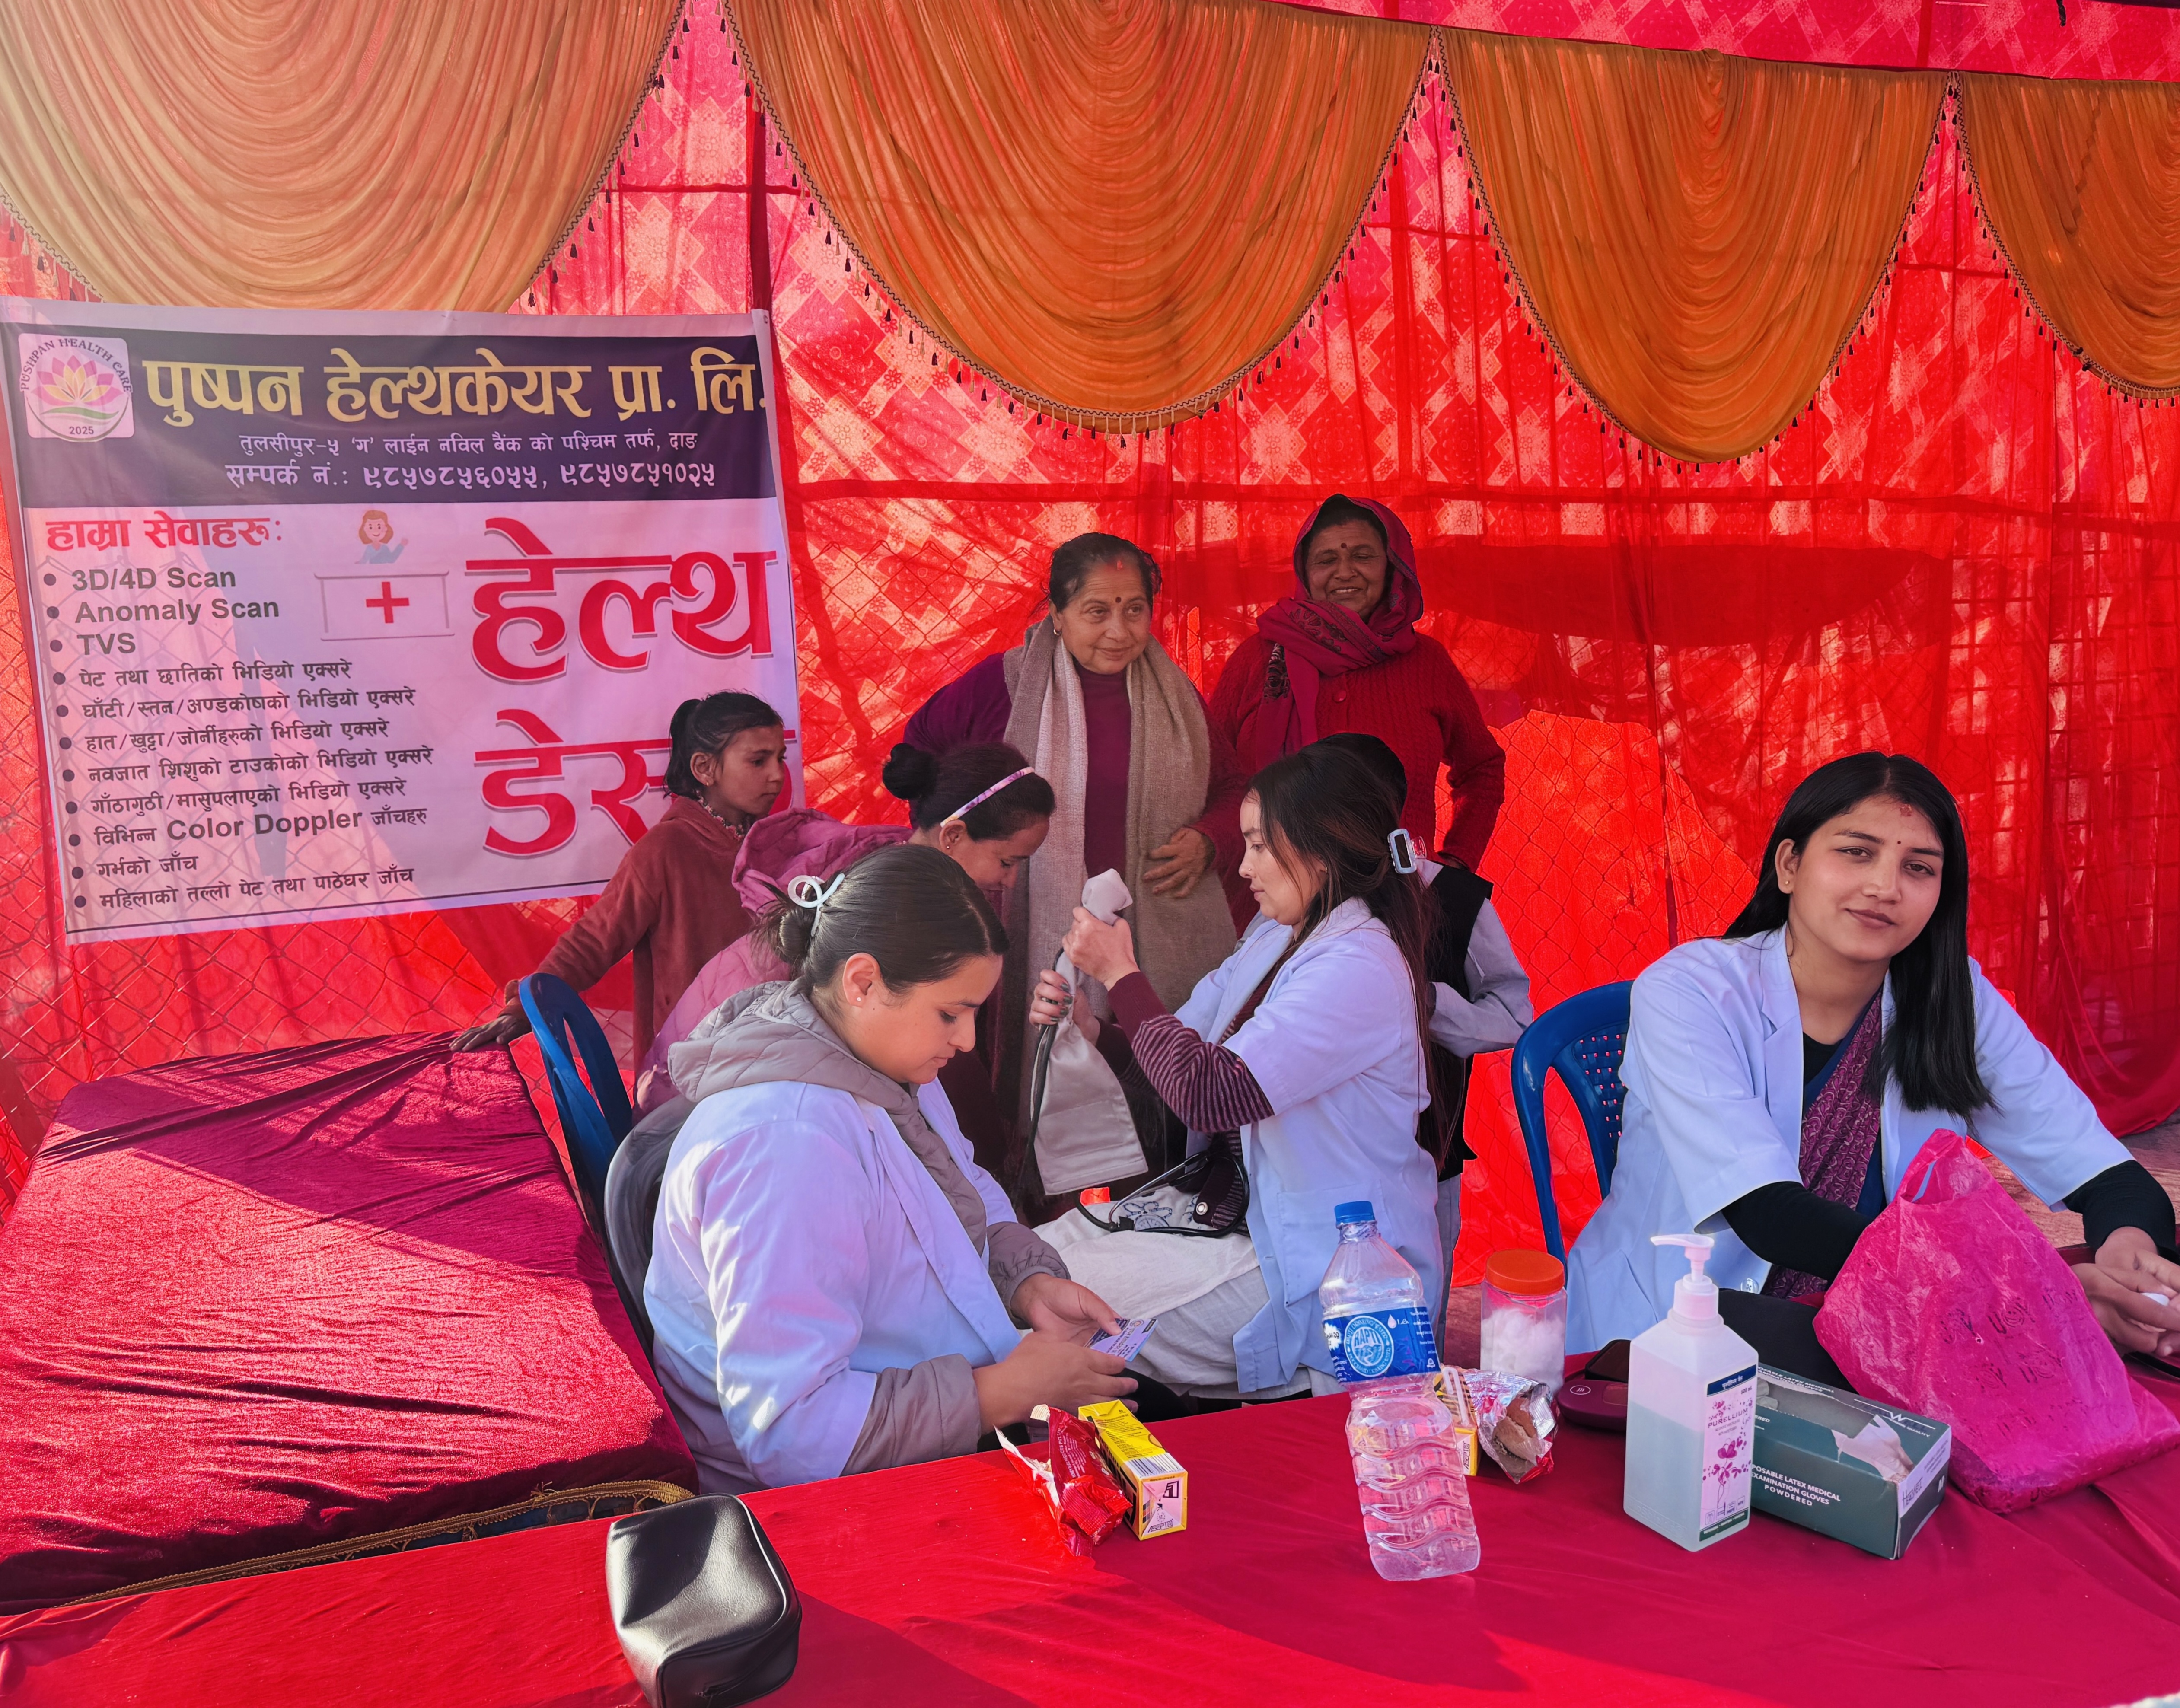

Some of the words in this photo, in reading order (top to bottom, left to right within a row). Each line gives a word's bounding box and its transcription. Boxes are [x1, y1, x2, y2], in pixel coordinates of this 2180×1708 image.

[20, 340, 55, 390] PUSHPAN
[58, 338, 113, 362] HEALTH
[112, 362, 132, 393] CARE
[142, 360, 304, 427] पुष्पन
[324, 348, 592, 422] हेल्थकेयर
[608, 366, 676, 421] प्रा.
[69, 426, 94, 435] 2025
[383, 433, 430, 455] लाईन
[493, 431, 522, 452] बैंक
[529, 433, 553, 452] को
[561, 430, 617, 451] पश्चिम
[624, 428, 660, 452] तर्फ,
[225, 459, 300, 488] सम्पर्क
[561, 463, 714, 487] ९८५७८५१०२५
[46, 520, 131, 551] हाम्रा
[72, 568, 156, 591] 3D/4D
[167, 567, 236, 588] Scan
[75, 599, 201, 625] Anomaly
[211, 598, 279, 619] Scan
[465, 517, 778, 683] हेल्थ
[76, 633, 136, 655] TVS
[79, 669, 105, 687] पेट
[115, 670, 148, 686] तथा
[157, 663, 224, 685] छातिको
[232, 660, 294, 681] भिडियो
[302, 658, 352, 681] एक्सरे
[297, 688, 359, 708] भिडियो
[366, 686, 416, 709] एक्सरे
[271, 720, 332, 740] भिडियो
[340, 717, 389, 740] एक्सरे
[88, 765, 150, 782] नवजात
[158, 757, 222, 781] शिशुको
[229, 752, 309, 774] टाउकोको
[316, 748, 377, 768] भिडियो
[384, 745, 434, 768] एक्सरे
[288, 780, 350, 800] भिडियो
[357, 776, 407, 800] एक्सरे
[94, 824, 157, 846] विभिन्न
[167, 817, 244, 840] Color
[254, 809, 362, 837] Doppler
[97, 856, 150, 877] गर्भको
[159, 851, 198, 872] जाँच
[99, 886, 178, 910] महिलाको
[186, 881, 231, 902] तल्लो
[239, 879, 264, 897] पेट
[272, 878, 306, 895] तथा
[313, 871, 369, 889] पाठेघर
[377, 864, 414, 885] जाँच
[1708, 1408, 1748, 1428] PURELLIUM
[1764, 1484, 1813, 1506] POWDERED
[1784, 1476, 1807, 1488] LATEX
[1807, 1484, 1841, 1501] MEDICAL
[1801, 1490, 1829, 1505] GLOVES
